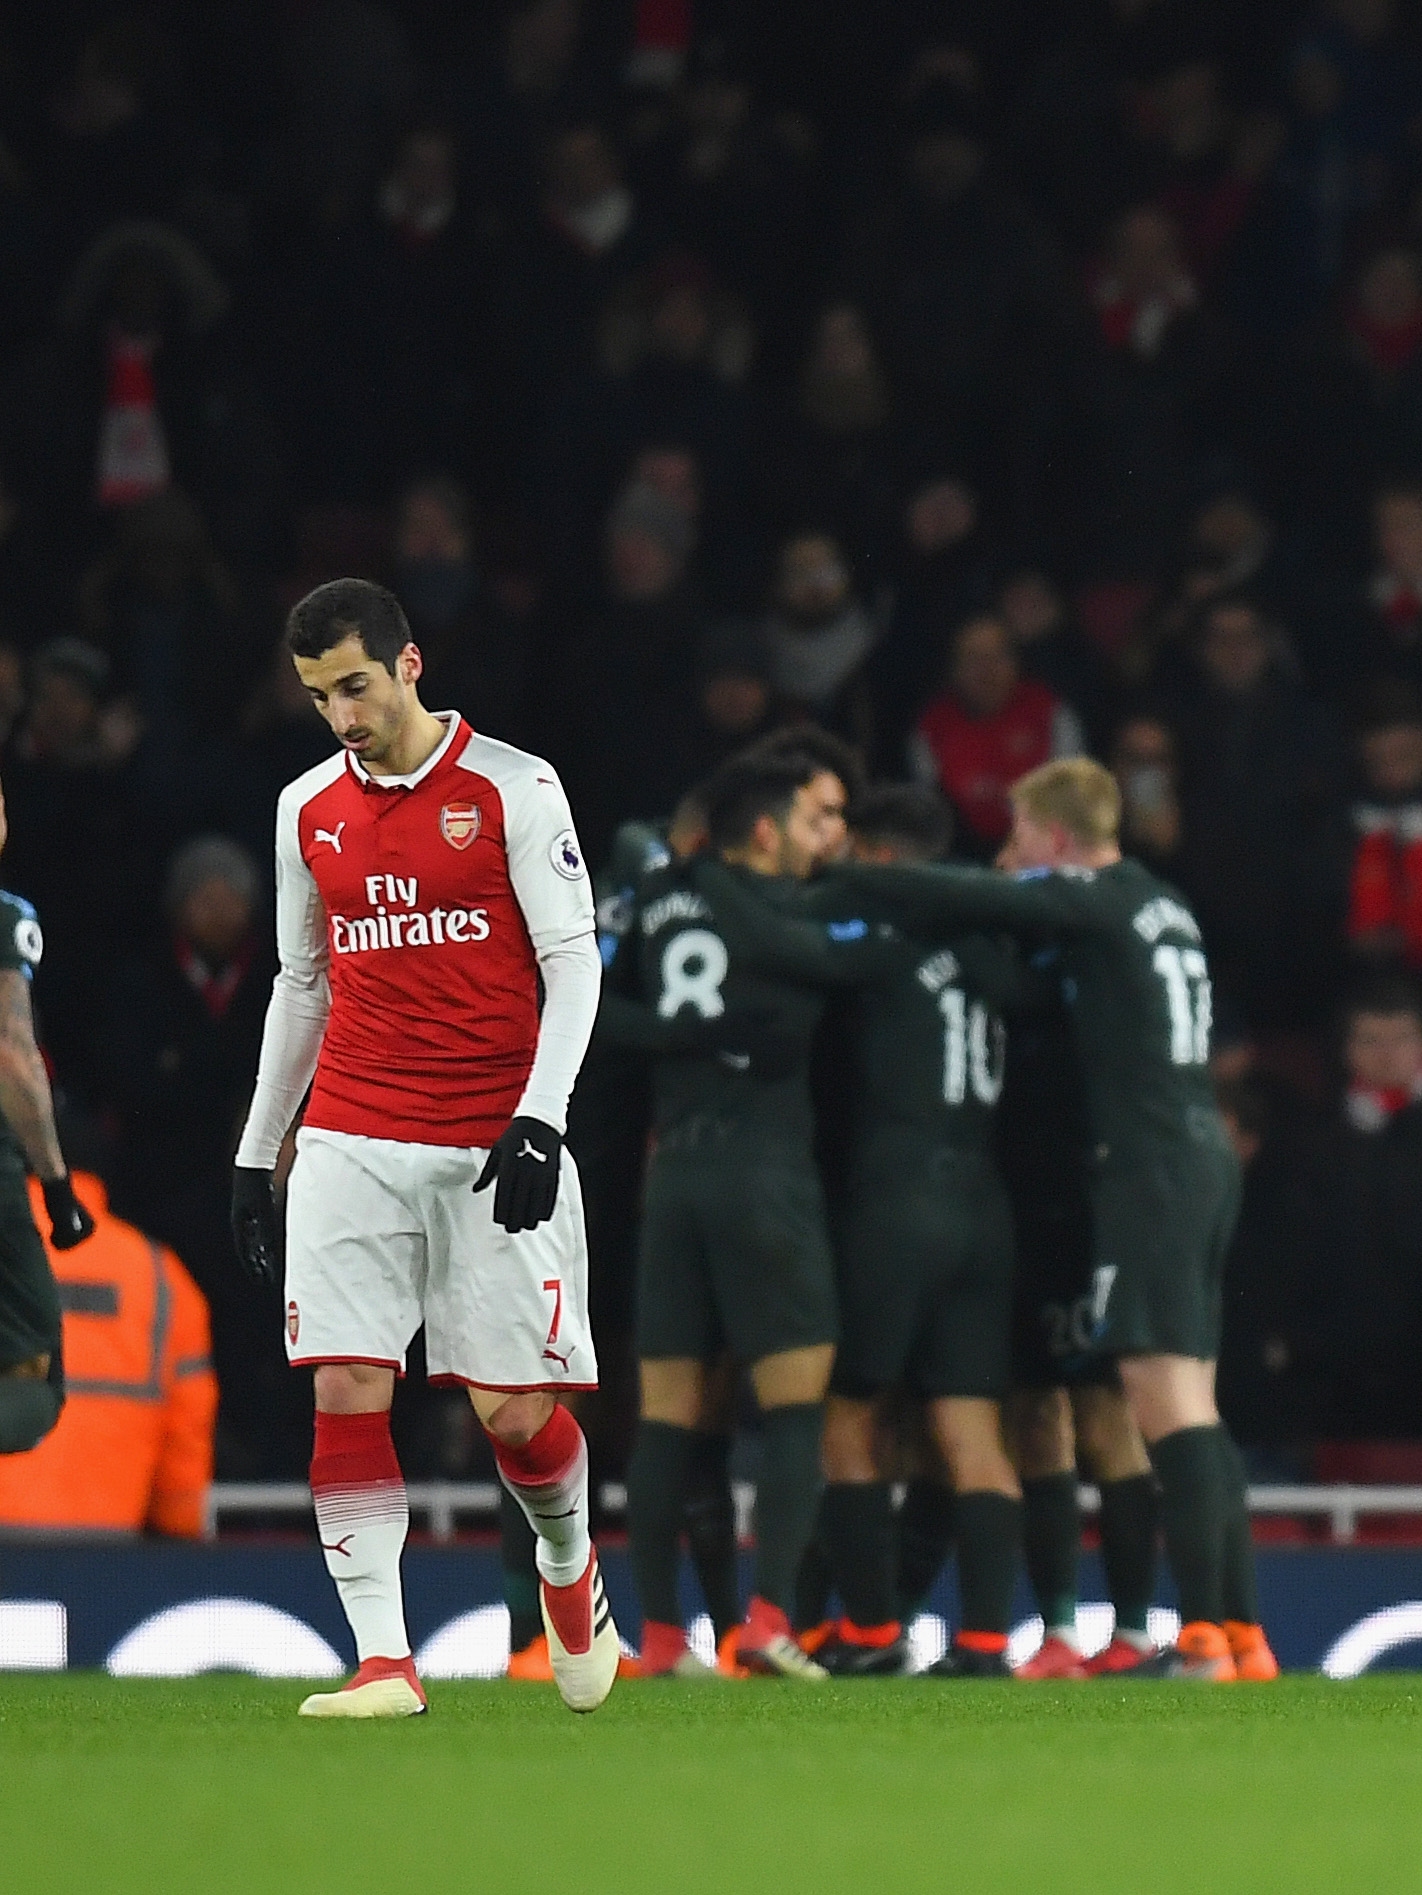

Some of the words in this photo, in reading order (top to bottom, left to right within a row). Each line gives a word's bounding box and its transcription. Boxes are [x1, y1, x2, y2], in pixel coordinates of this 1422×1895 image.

[365, 873, 418, 907] Fly
[331, 906, 490, 954] Emirates
[1152, 944, 1213, 1065] 17
[938, 986, 1007, 1104] 10
[543, 1279, 562, 1344] 7
